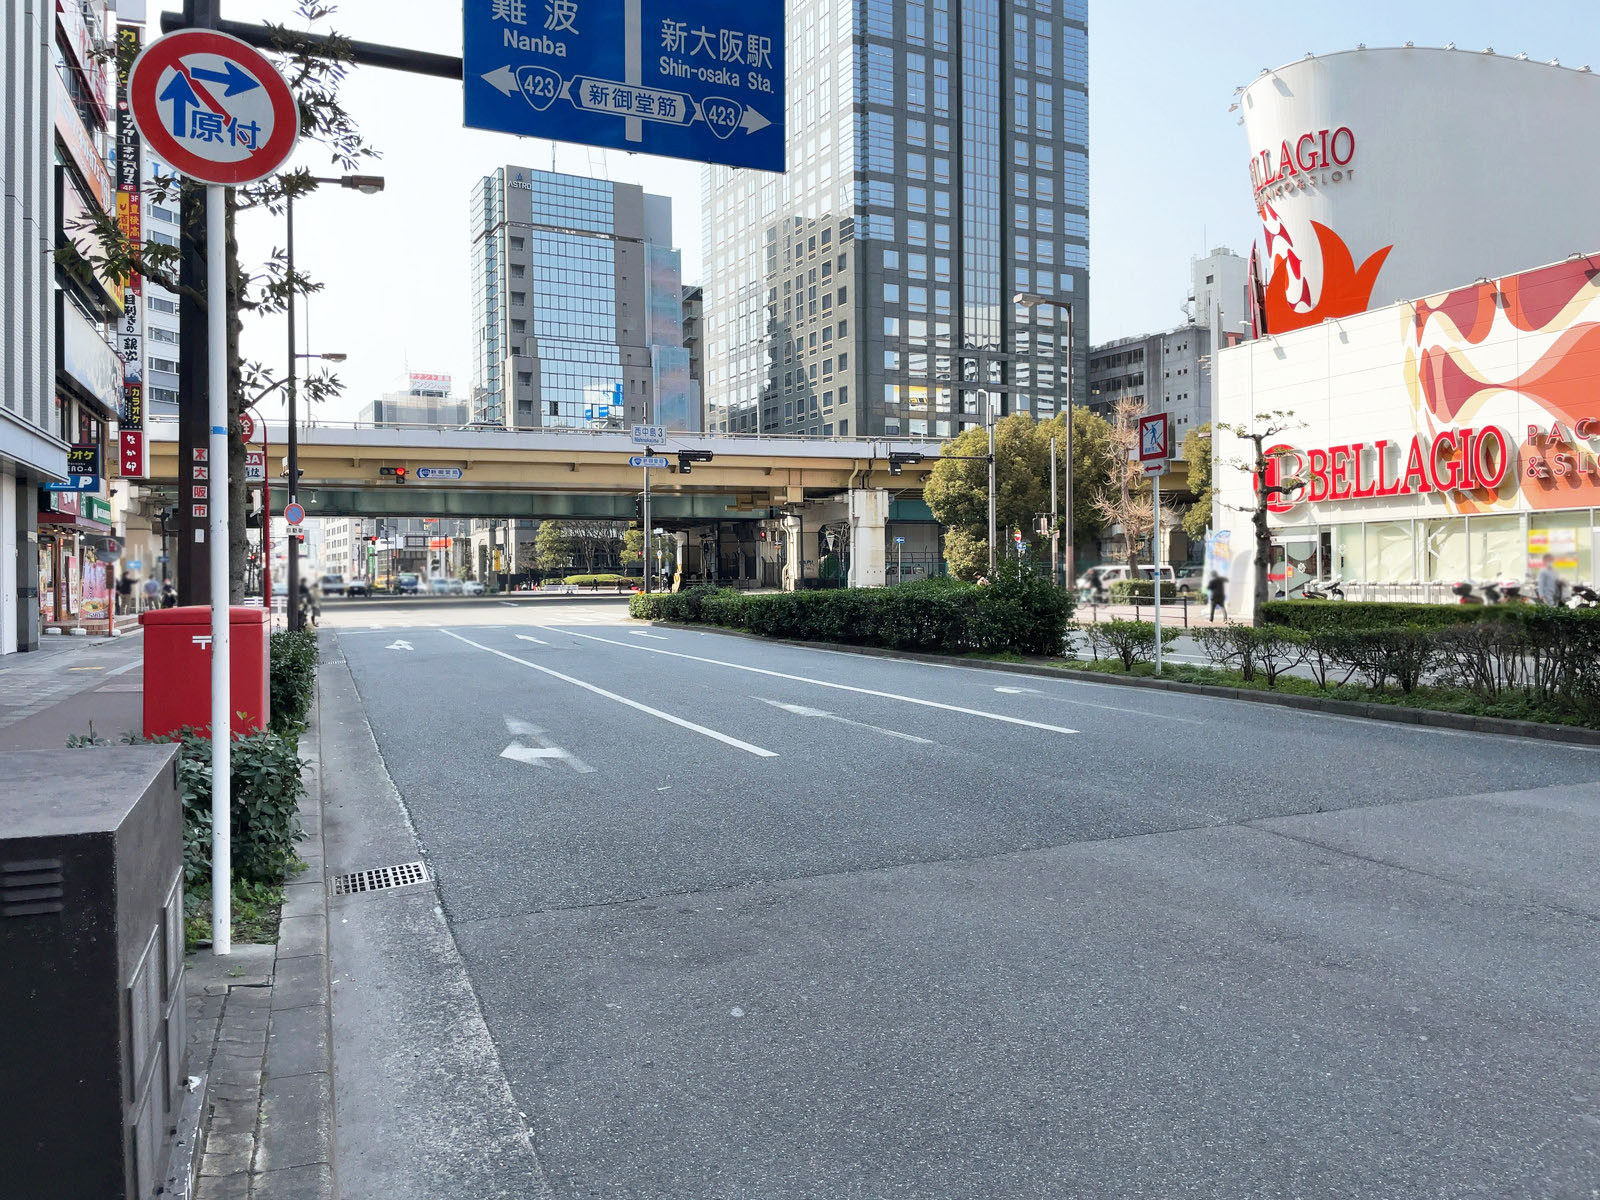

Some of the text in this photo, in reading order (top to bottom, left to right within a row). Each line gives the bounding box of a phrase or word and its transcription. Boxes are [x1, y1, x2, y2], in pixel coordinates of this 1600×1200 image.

[491, 0, 579, 35] 難波
[503, 28, 567, 58] Nanba
[661, 18, 772, 69] 新大阪駅
[524, 74, 554, 98] 423
[659, 57, 775, 94] Shin-osaka Sta.
[589, 84, 677, 118] 新御堂筋
[708, 105, 736, 127] 423
[190, 112, 261, 151] 原付
[1249, 126, 1355, 193] LLAGIO
[130, 195, 139, 203] 3F
[132, 388, 140, 424] カラオケ
[634, 427, 663, 437] 西中島 3
[126, 434, 137, 473] なか卯
[1307, 425, 1507, 502] BELLAGIO
[1553, 452, 1600, 476] SL
[78, 476, 93, 489] P
[193, 466, 207, 516] 大阪市
